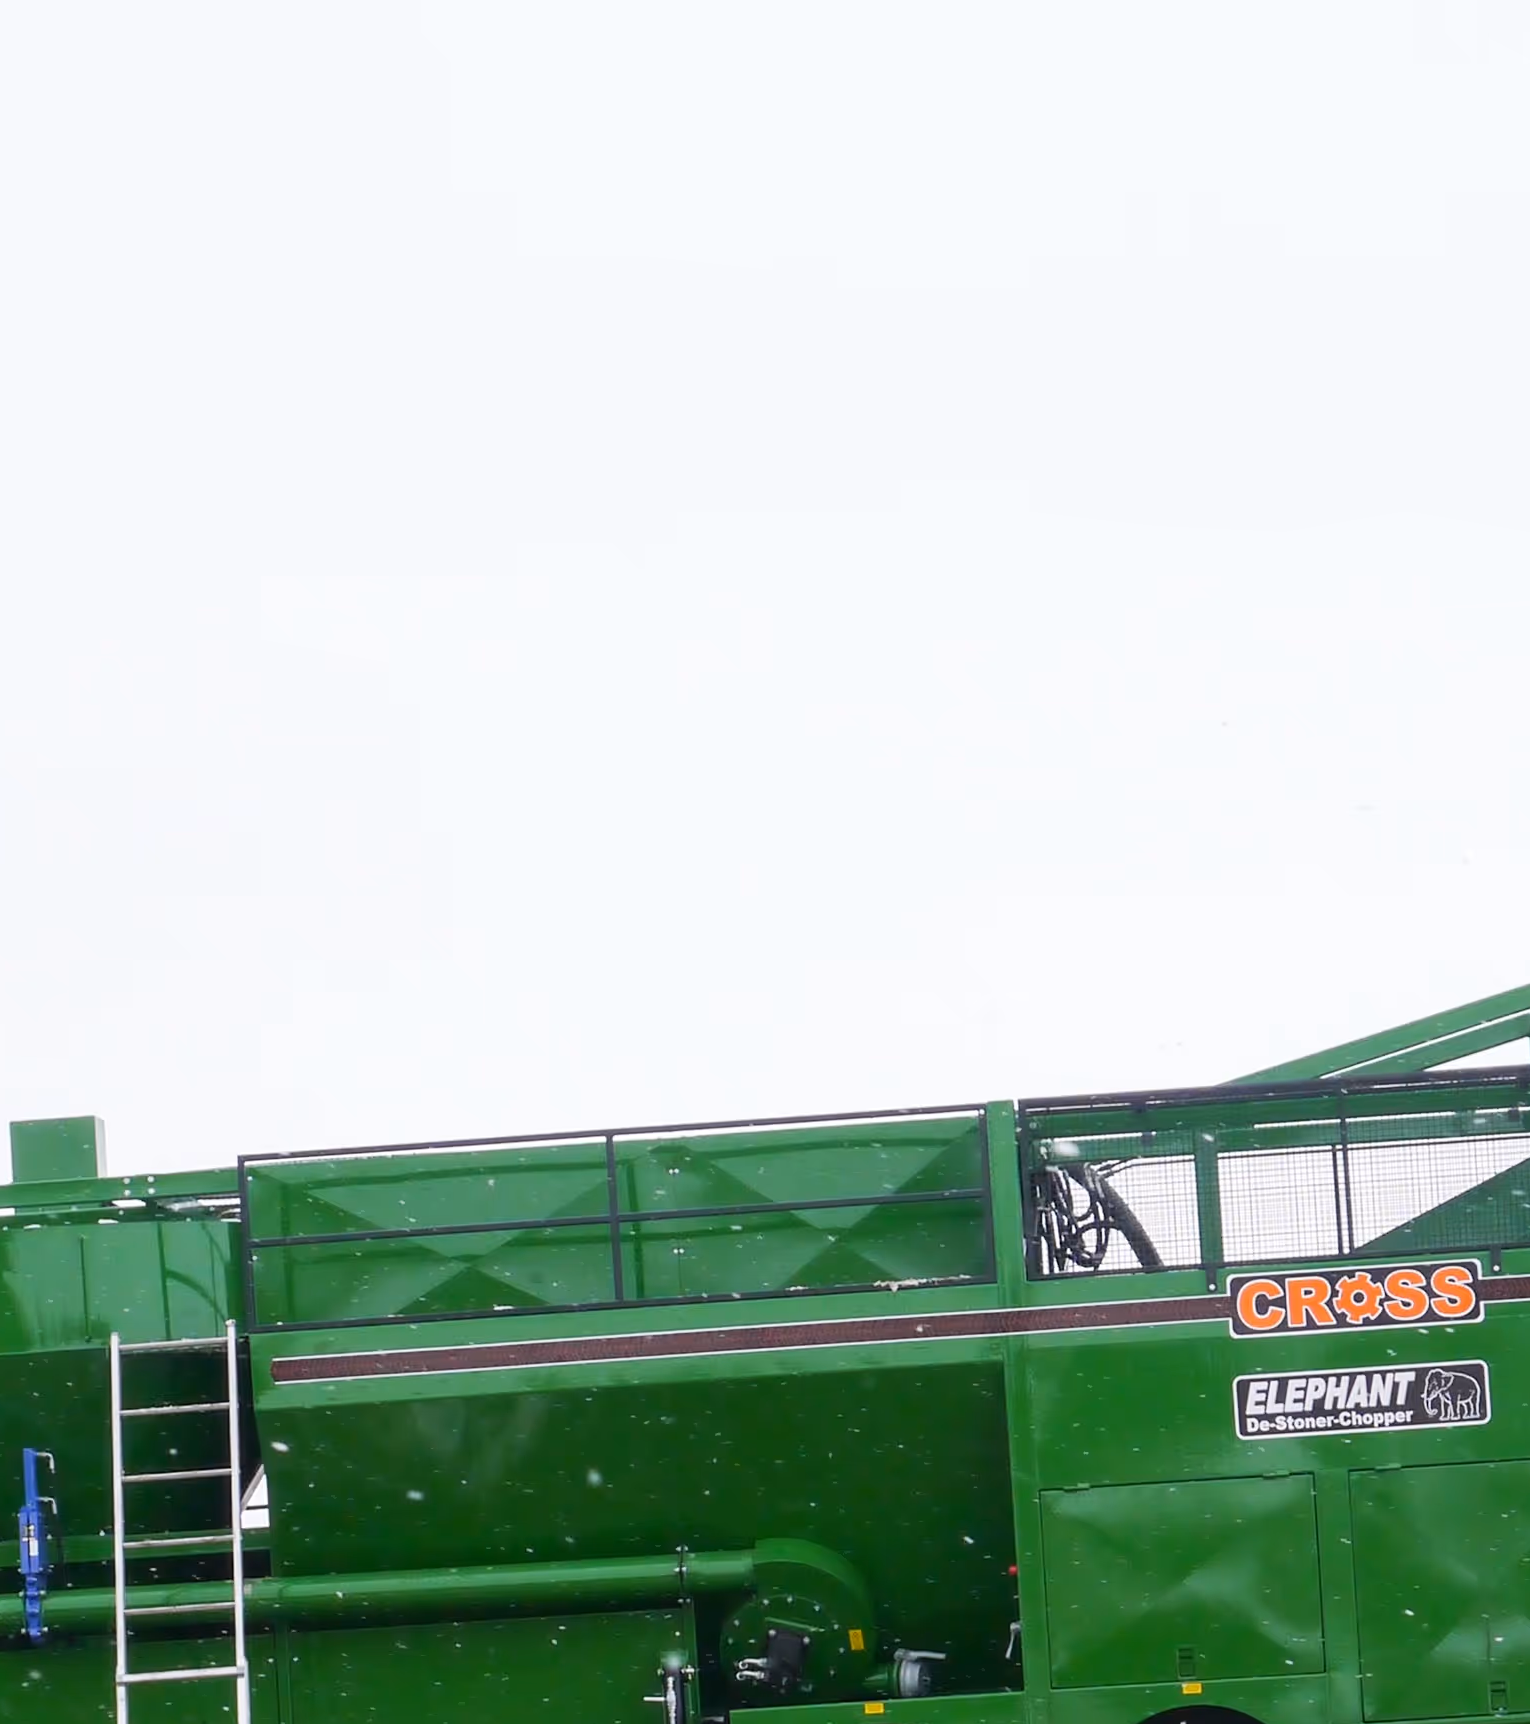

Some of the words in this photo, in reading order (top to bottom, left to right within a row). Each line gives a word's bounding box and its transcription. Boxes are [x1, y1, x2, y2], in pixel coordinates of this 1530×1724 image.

[1236, 1265, 1476, 1330] CROSS
[1245, 1371, 1416, 1415] ELEPHANT
[1246, 1410, 1414, 1433] De-Stoner-Chopper
